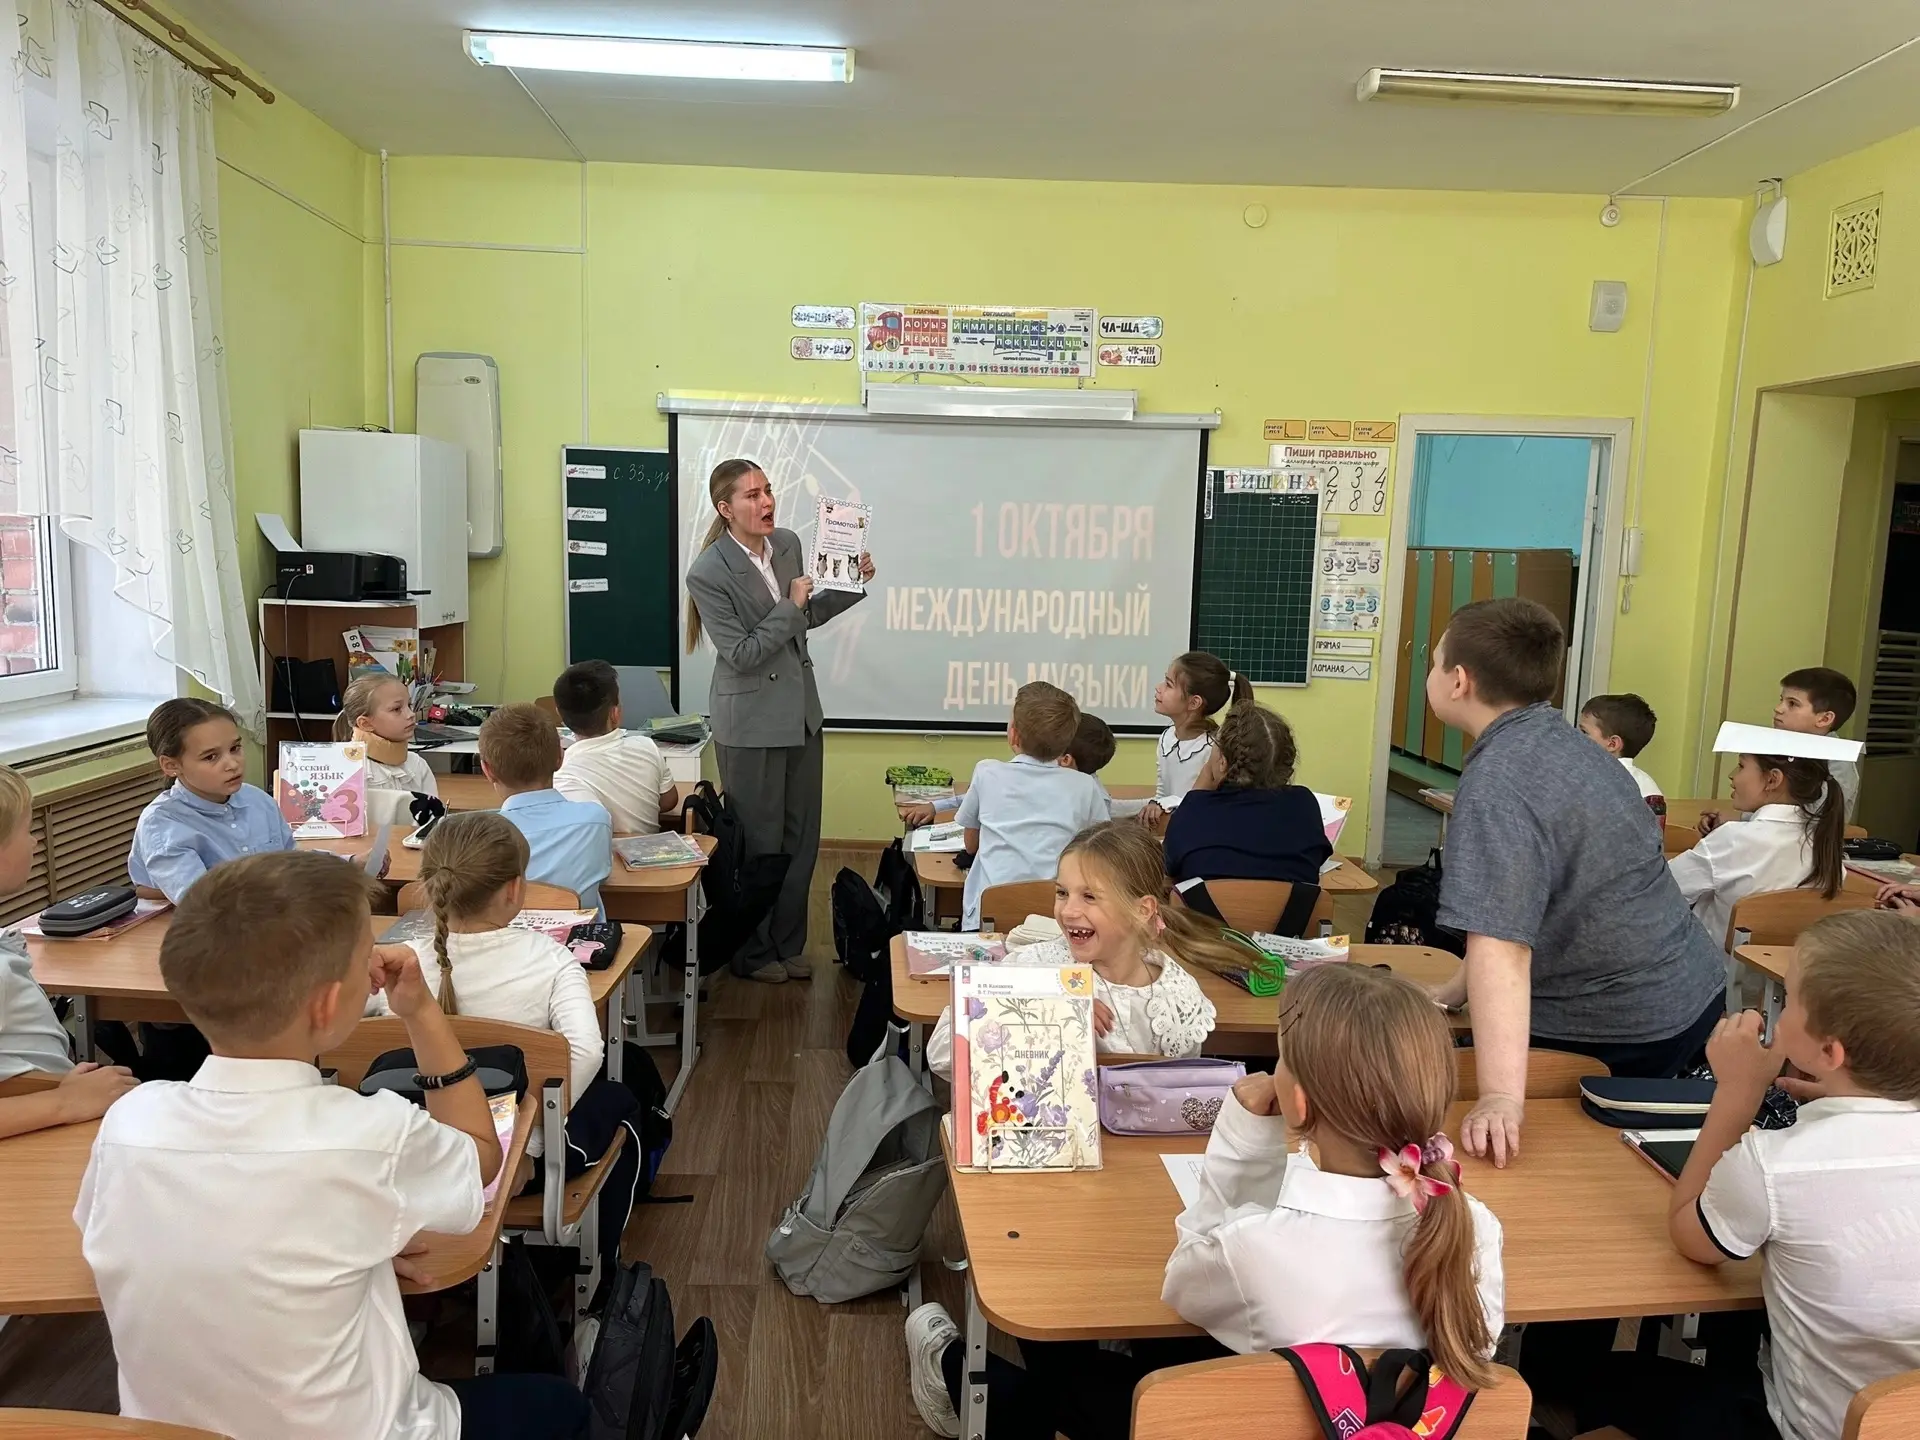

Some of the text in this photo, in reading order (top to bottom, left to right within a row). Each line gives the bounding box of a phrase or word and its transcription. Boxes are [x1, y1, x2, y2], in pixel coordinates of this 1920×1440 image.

[1101, 322, 1140, 333] ЧА-ЩА
[816, 344, 852, 354] ЧУ-ЩУ
[1284, 446, 1377, 460] Пиши правильно
[1226, 474, 1318, 491] ТИШИНА
[1327, 466, 1386, 489] 2 3 4
[1325, 490, 1337, 511] 7
[1350, 490, 1361, 512] 8
[1373, 490, 1385, 513] 9
[971, 501, 1154, 560] 1 ОКТЯБРЯ
[886, 583, 1152, 639] МЕЖДУНАРОДНЫЙ
[1316, 641, 1341, 649] ПРЯМАЯ
[1313, 664, 1345, 673] ЛОМАНАЯ
[944, 660, 1018, 710] ДЕНЬ
[286, 761, 330, 772] Русский
[332, 790, 360, 824] 3
[1014, 1050, 1050, 1059] ДНЕВНИК
